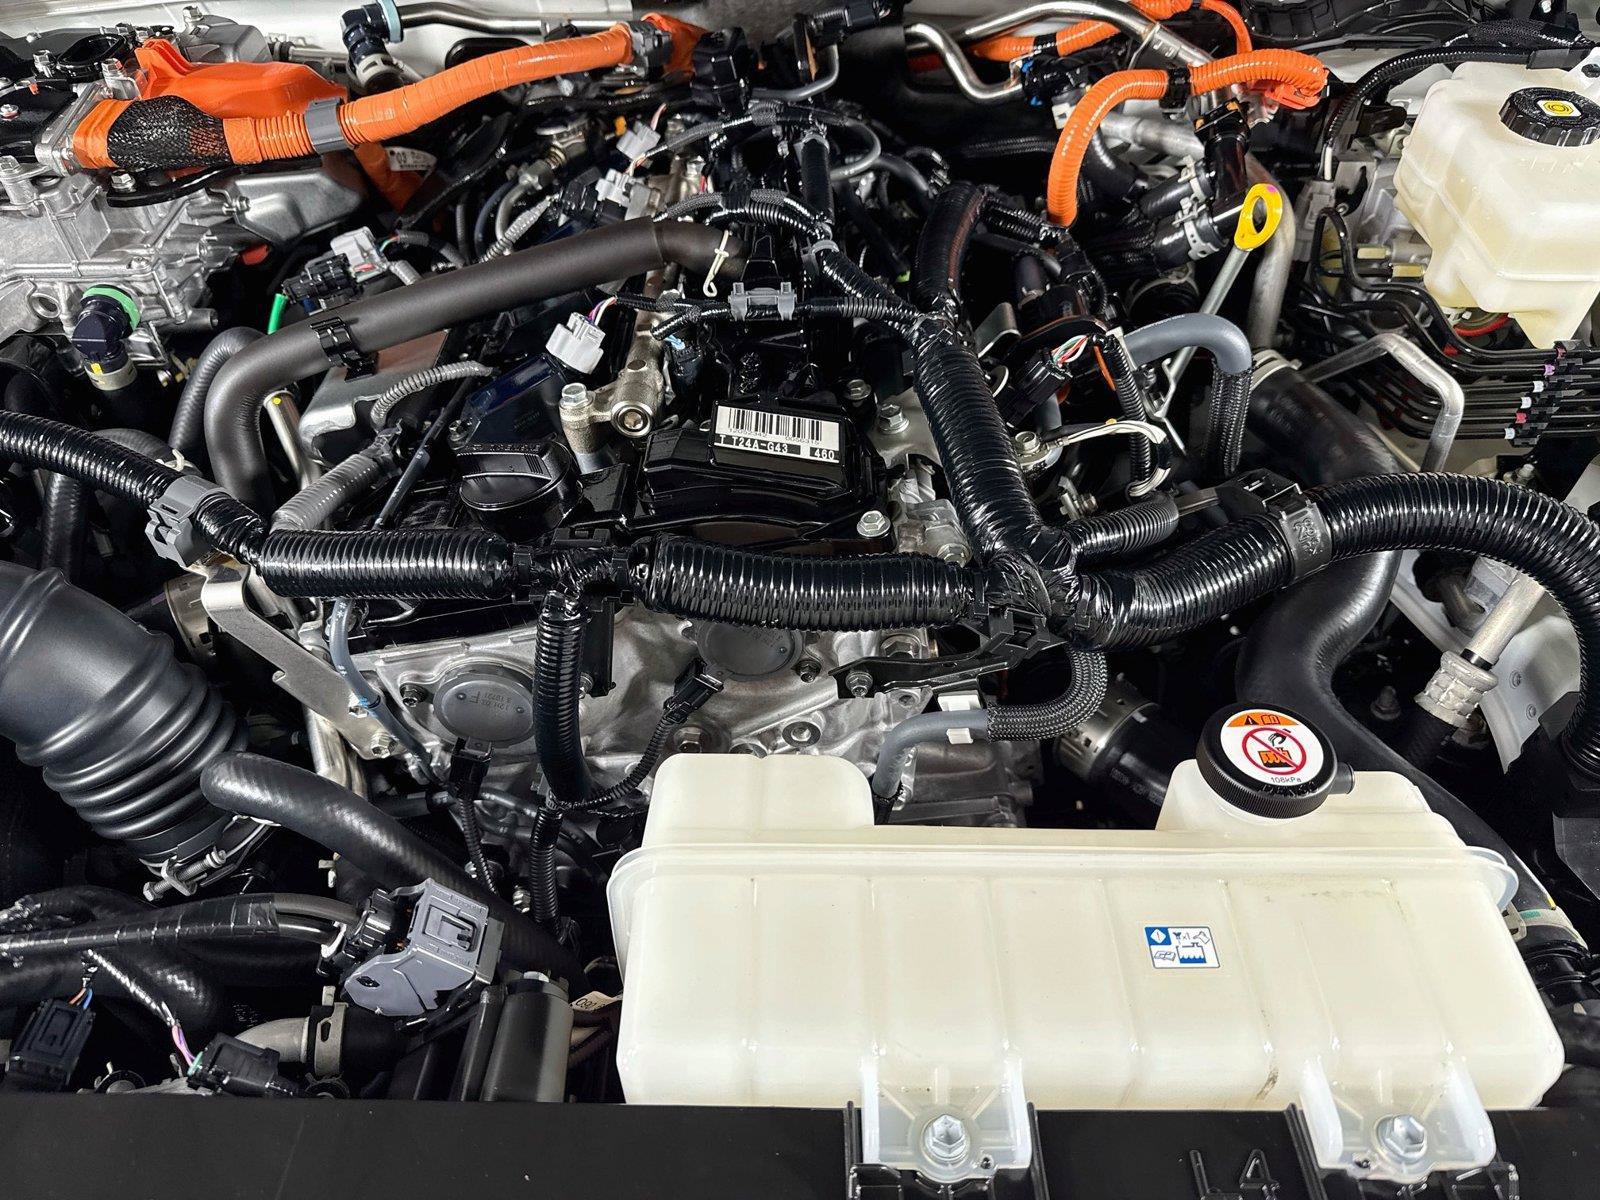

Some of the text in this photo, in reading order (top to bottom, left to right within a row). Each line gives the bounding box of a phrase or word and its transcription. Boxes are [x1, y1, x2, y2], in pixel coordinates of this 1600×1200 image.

[719, 434, 836, 461] T T24A-G43 460
[1270, 775, 1302, 785] 108kPa
